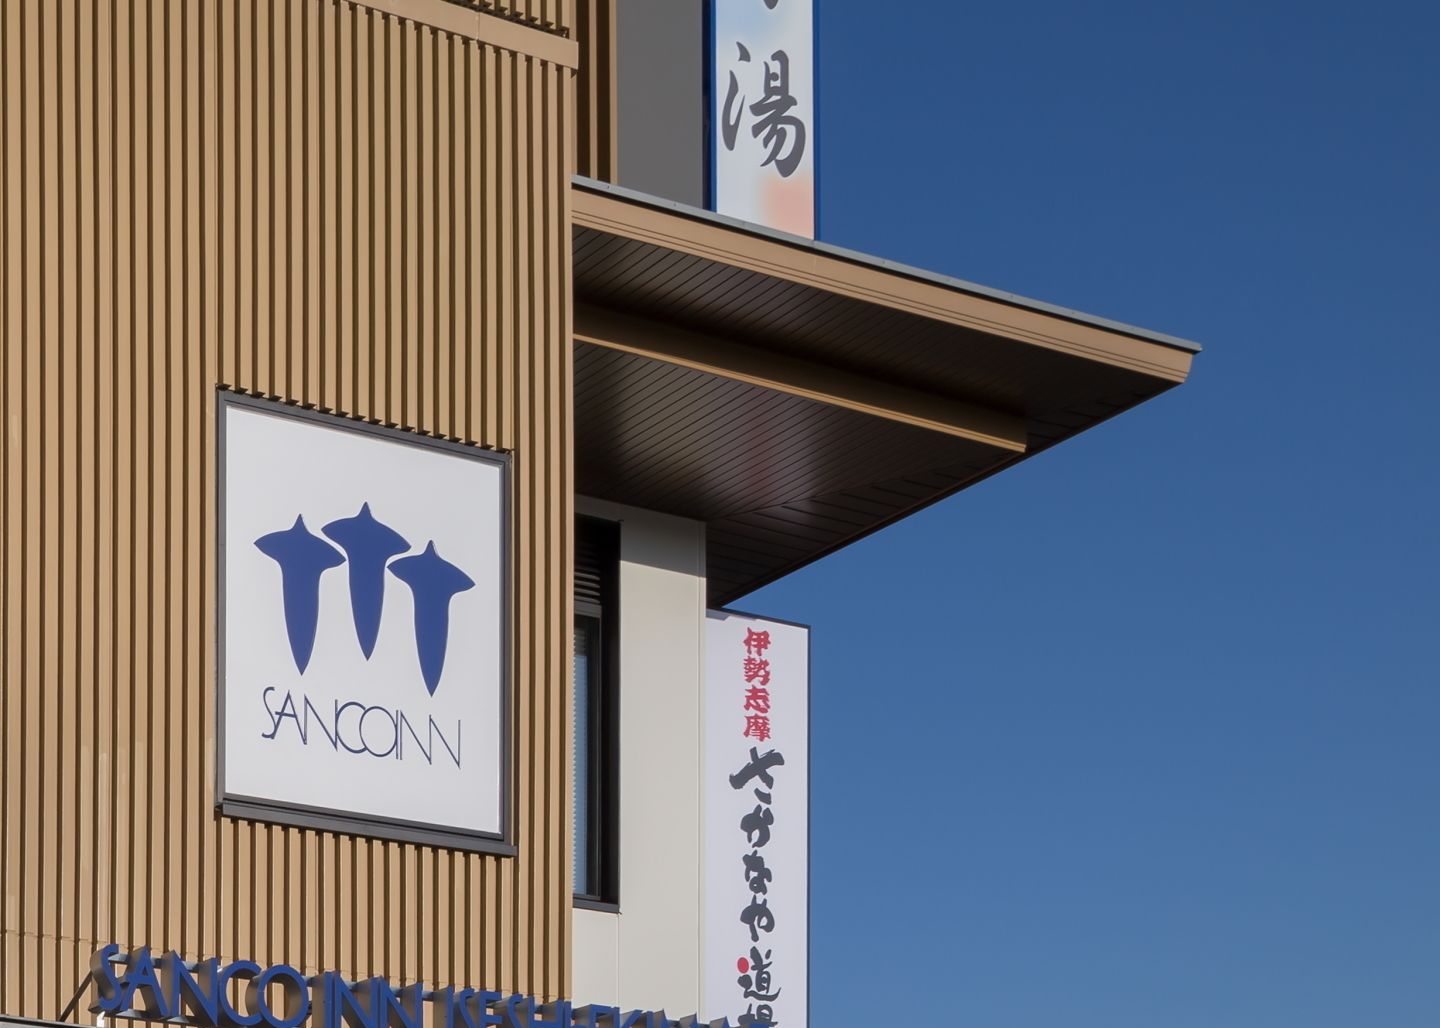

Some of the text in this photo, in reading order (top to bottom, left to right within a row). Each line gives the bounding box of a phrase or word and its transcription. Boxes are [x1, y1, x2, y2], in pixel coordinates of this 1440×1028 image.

[721, 0, 806, 178] 湯
[261, 686, 461, 768] SANCOINN
[742, 627, 772, 742] 伊勢志摩
[94, 944, 309, 1028] SANCO
